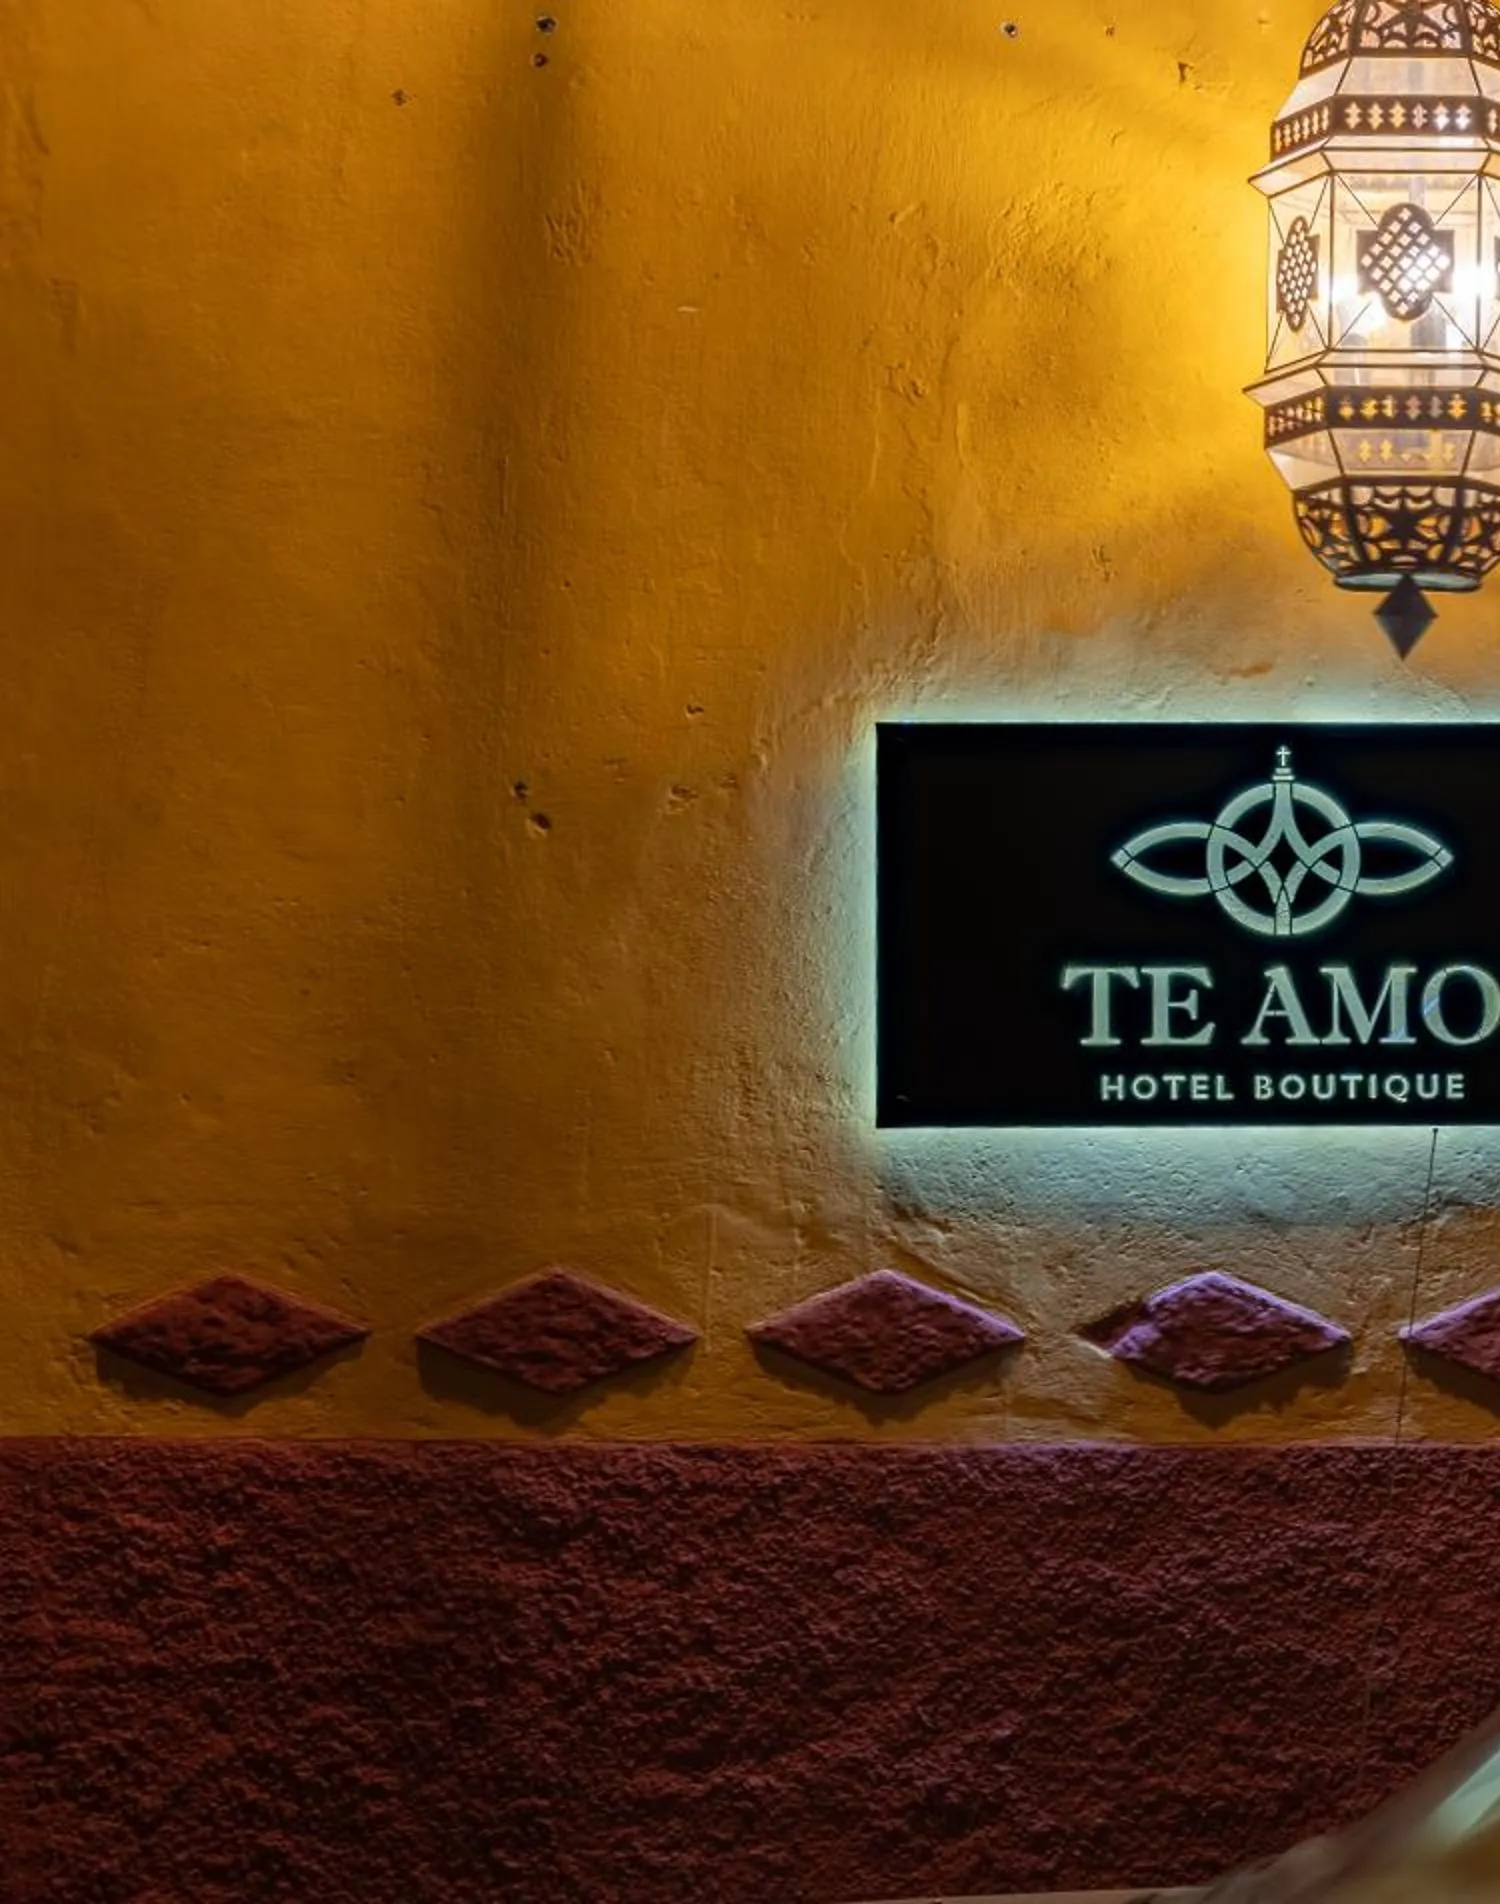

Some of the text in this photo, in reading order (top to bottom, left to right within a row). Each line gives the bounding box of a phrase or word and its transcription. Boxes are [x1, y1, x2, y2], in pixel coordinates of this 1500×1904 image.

[1061, 965, 1216, 1046] TE
[1101, 1074, 1465, 1103] HOTEL BOUTIQUE
